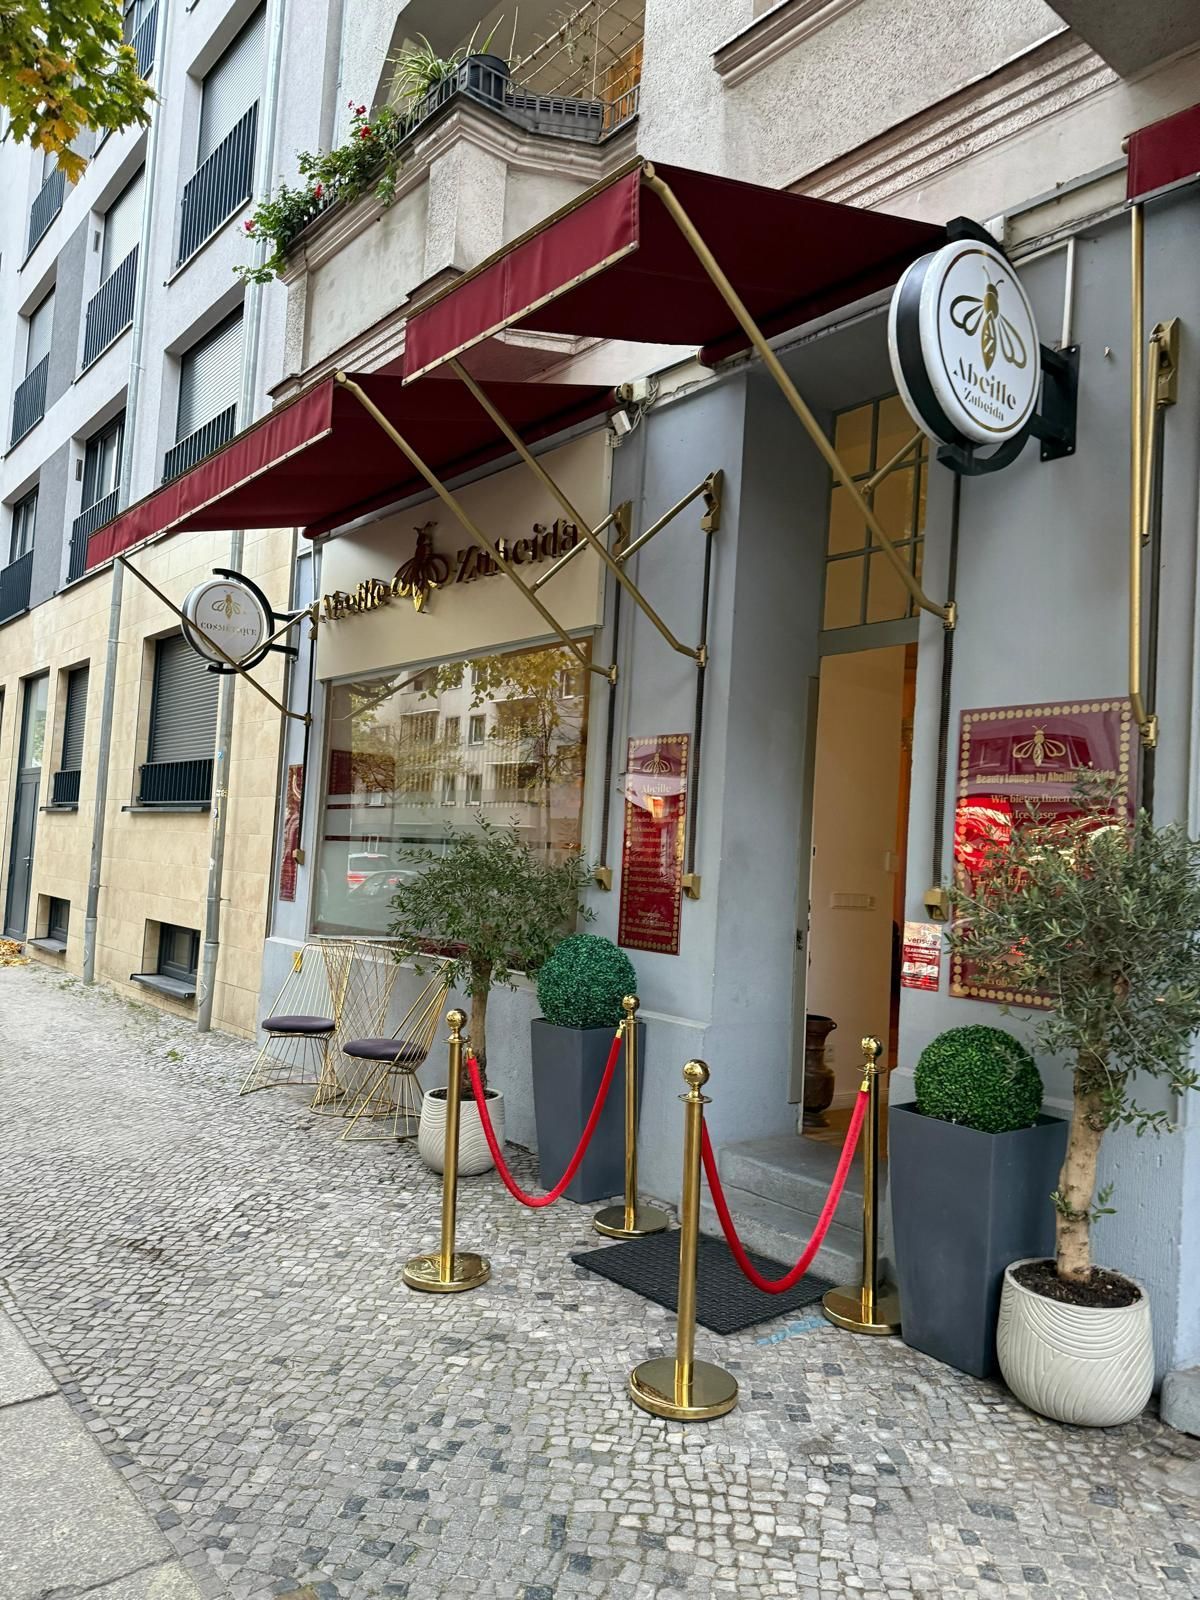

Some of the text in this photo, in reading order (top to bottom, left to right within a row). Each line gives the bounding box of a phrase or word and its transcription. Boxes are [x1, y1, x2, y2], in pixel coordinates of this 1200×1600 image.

[953, 357, 1017, 410] Abeille
[963, 388, 1005, 422] Zubeida
[975, 775, 1004, 784] Beauty
[1005, 774, 1034, 784] Lounge
[1036, 773, 1046, 783] by
[991, 795, 1008, 803] Wir
[1010, 795, 1040, 803] bieten
[1042, 794, 1070, 803] Ihnen
